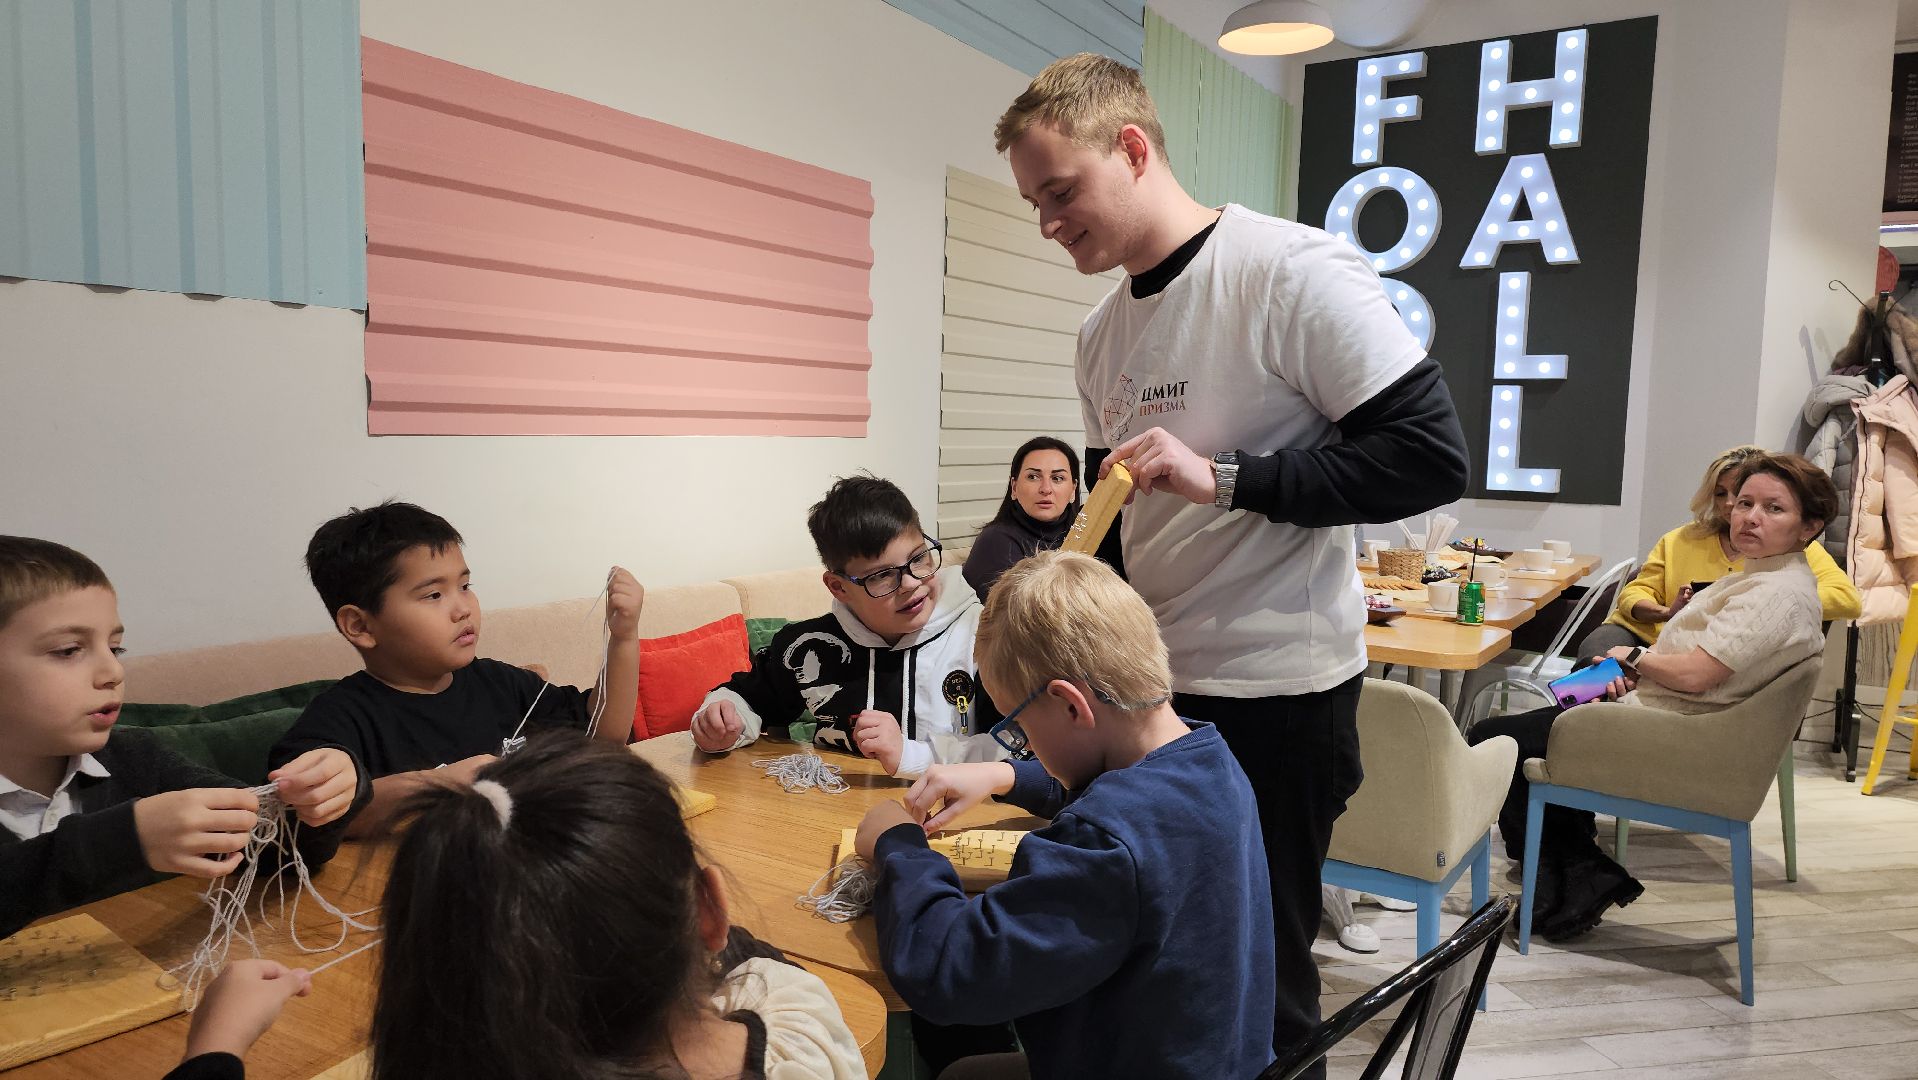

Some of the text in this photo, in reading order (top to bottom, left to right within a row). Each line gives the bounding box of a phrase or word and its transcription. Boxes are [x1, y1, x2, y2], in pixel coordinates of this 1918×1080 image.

[1325, 51, 1442, 353] FO
[1460, 28, 1589, 494] HALL
[1139, 400, 1187, 417] ПРИЗМА
[1140, 381, 1189, 402] ЦМИТ
